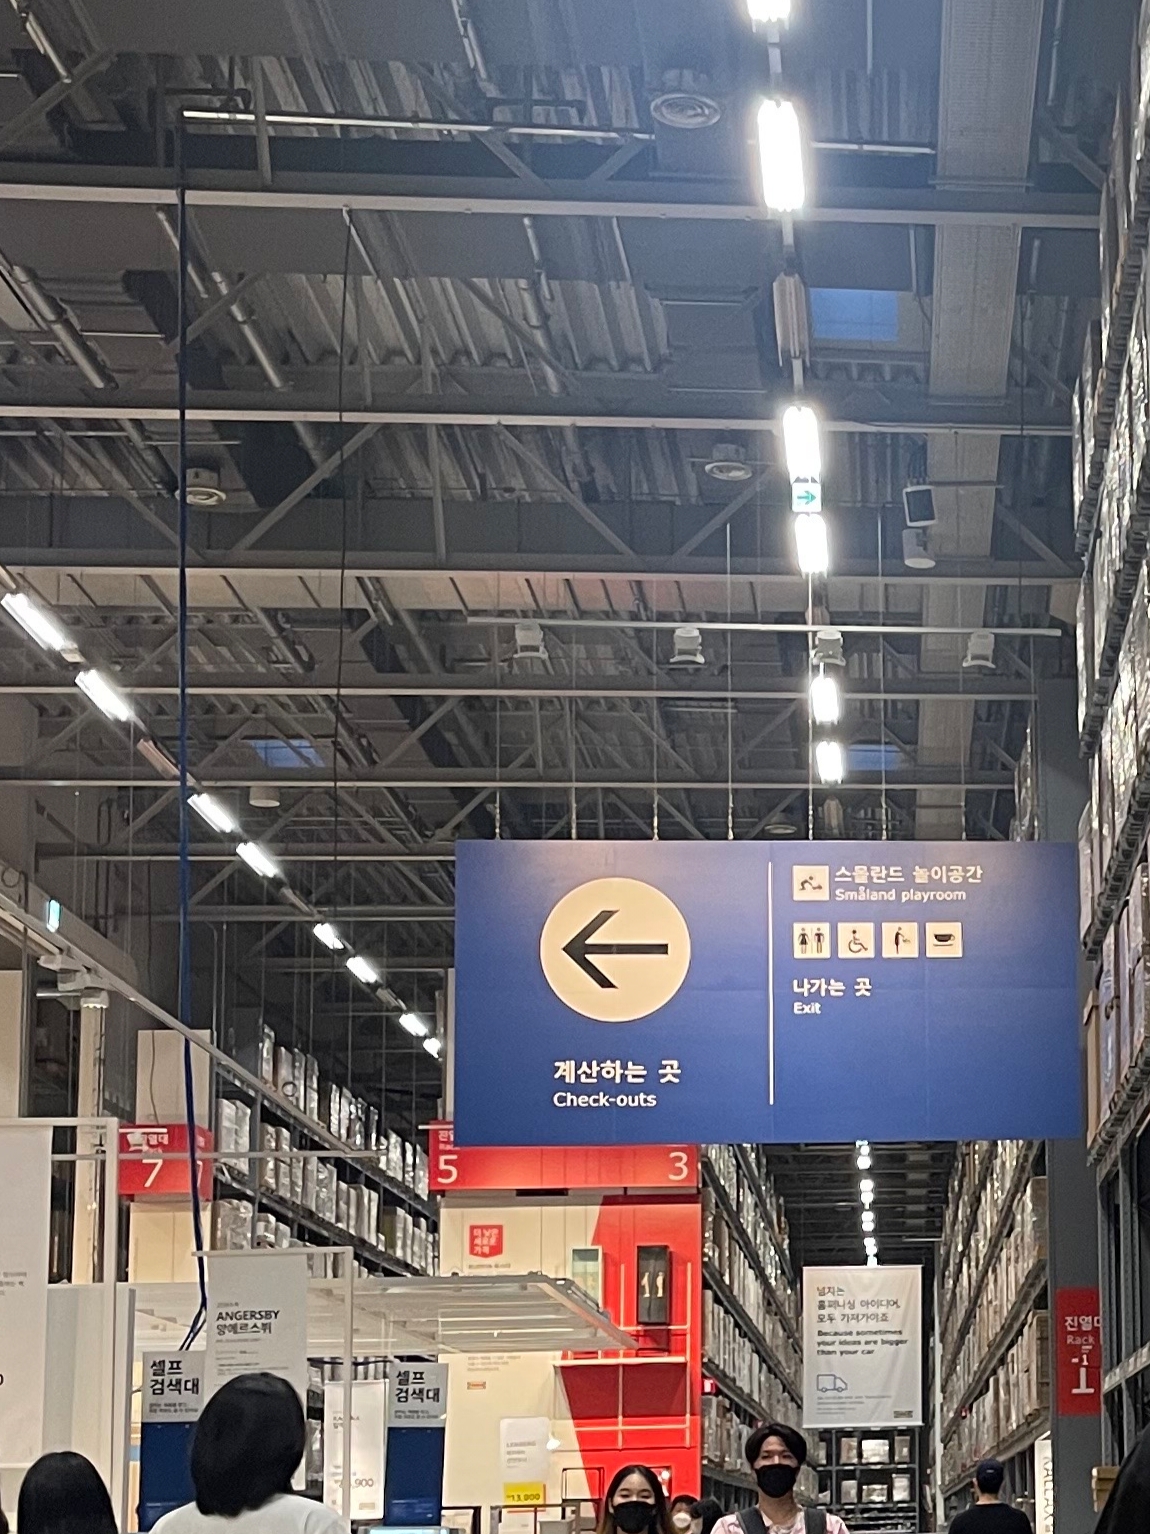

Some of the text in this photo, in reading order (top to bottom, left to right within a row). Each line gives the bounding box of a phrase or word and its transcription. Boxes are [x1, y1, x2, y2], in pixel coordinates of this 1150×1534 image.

[833, 865, 984, 884] 스몰란드 놀이공간
[834, 885, 967, 903] Småland playroom
[792, 977, 873, 997] 나가는 곳
[792, 1002, 822, 1015] Exit
[553, 1059, 682, 1084] 계산하는 곳
[552, 1091, 657, 1107] Check-outs
[142, 1159, 164, 1188] 7
[437, 1154, 459, 1184] 5
[667, 1151, 689, 1181] 3
[215, 1310, 281, 1322] ANGERSBY
[1066, 1334, 1095, 1345] Rack
[150, 1359, 184, 1377] 셀프
[149, 1378, 200, 1396] 검색대
[396, 1370, 426, 1386] 셀프
[395, 1387, 440, 1403] 검색대
